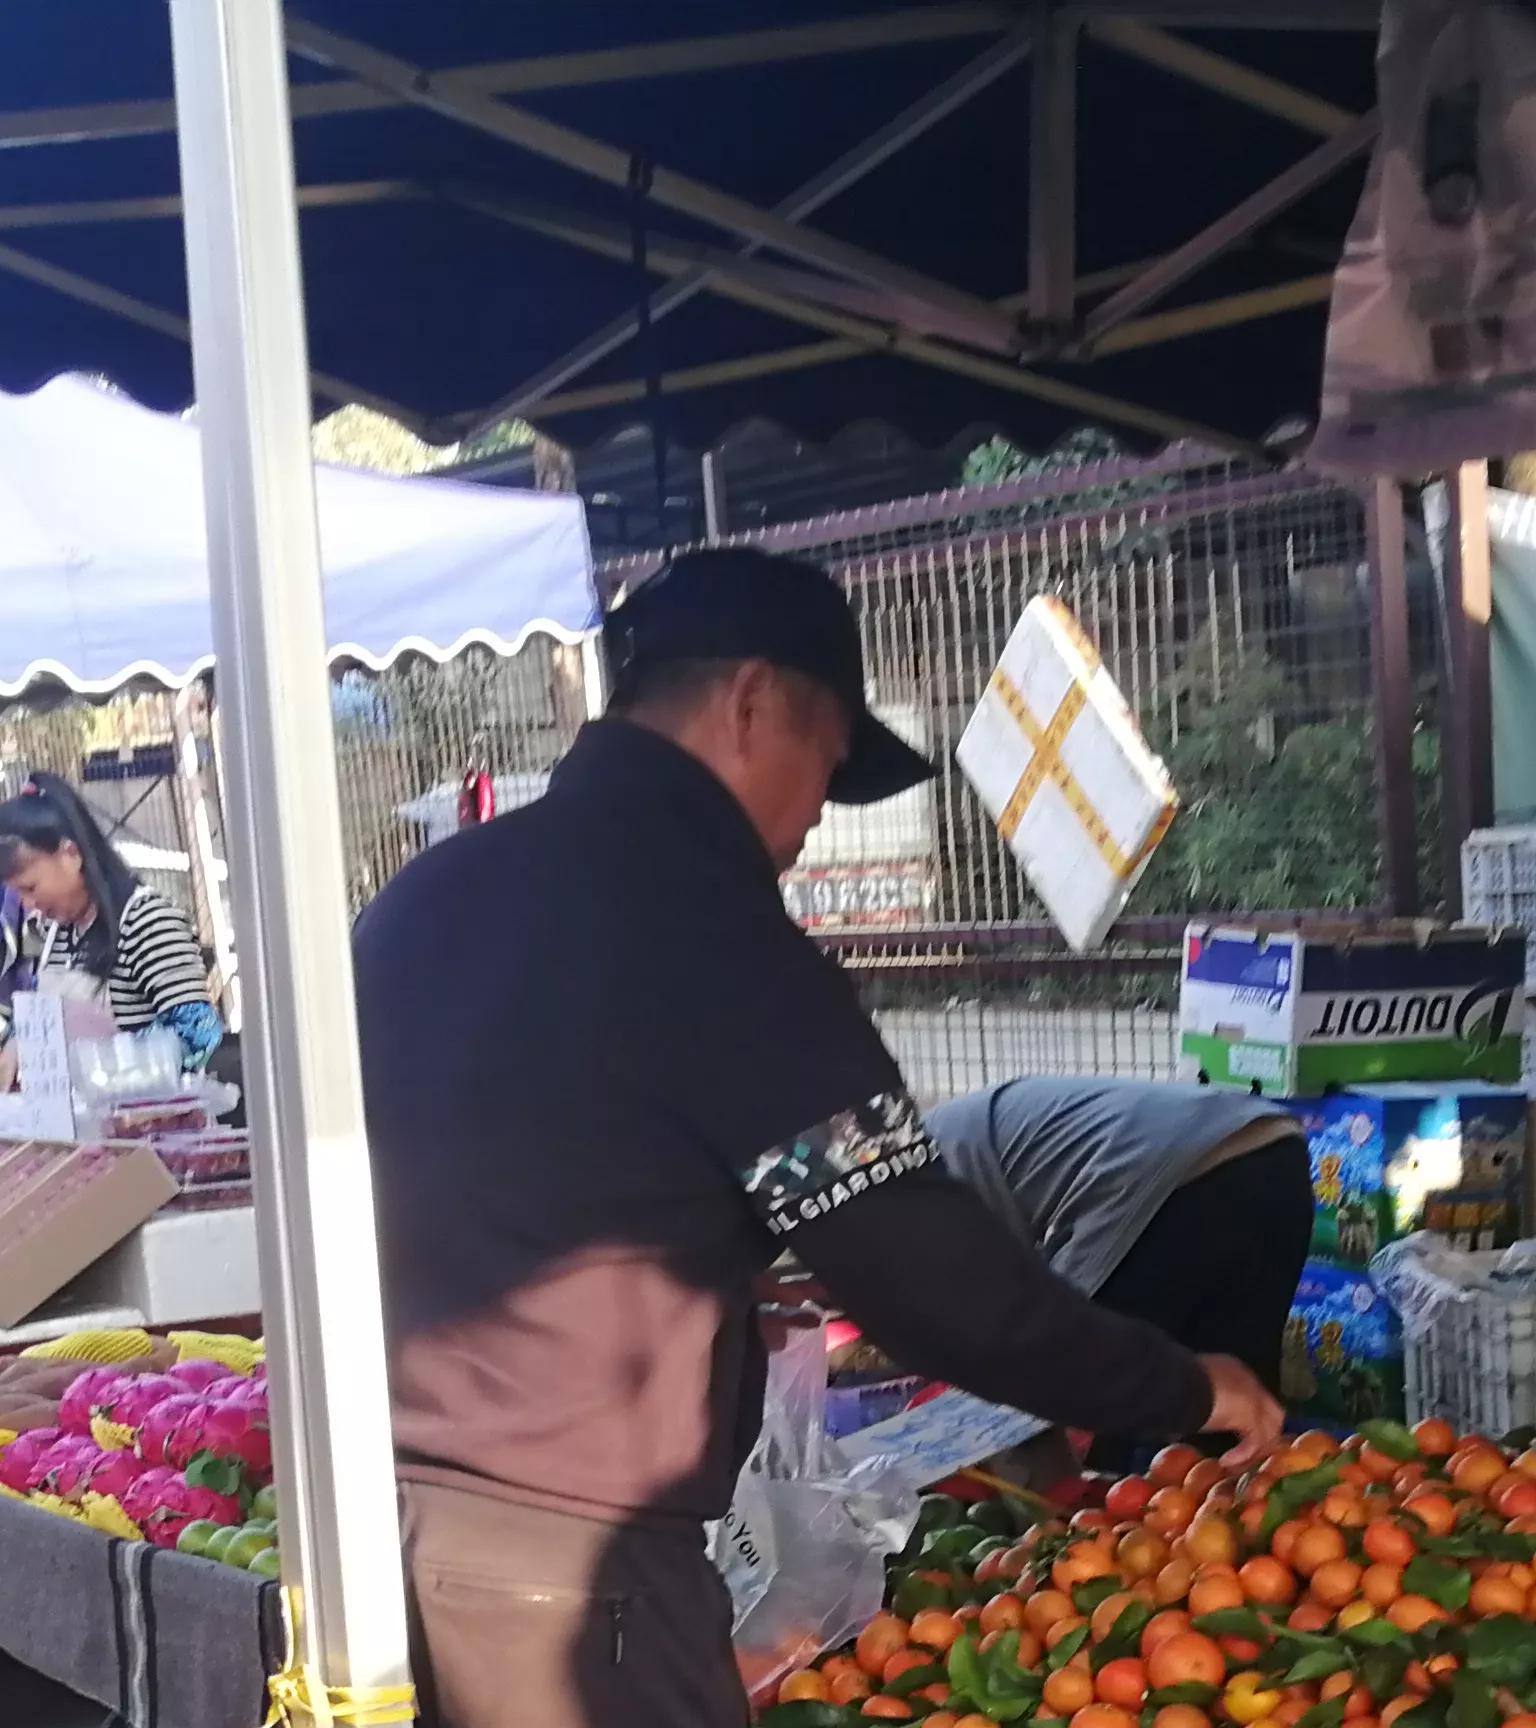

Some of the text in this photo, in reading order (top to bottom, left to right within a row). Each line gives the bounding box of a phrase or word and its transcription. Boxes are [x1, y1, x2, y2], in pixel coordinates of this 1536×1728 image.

[1310, 995, 1454, 1039] DUTOIT
[766, 1210, 799, 1236] IL
[731, 1520, 762, 1568] You
